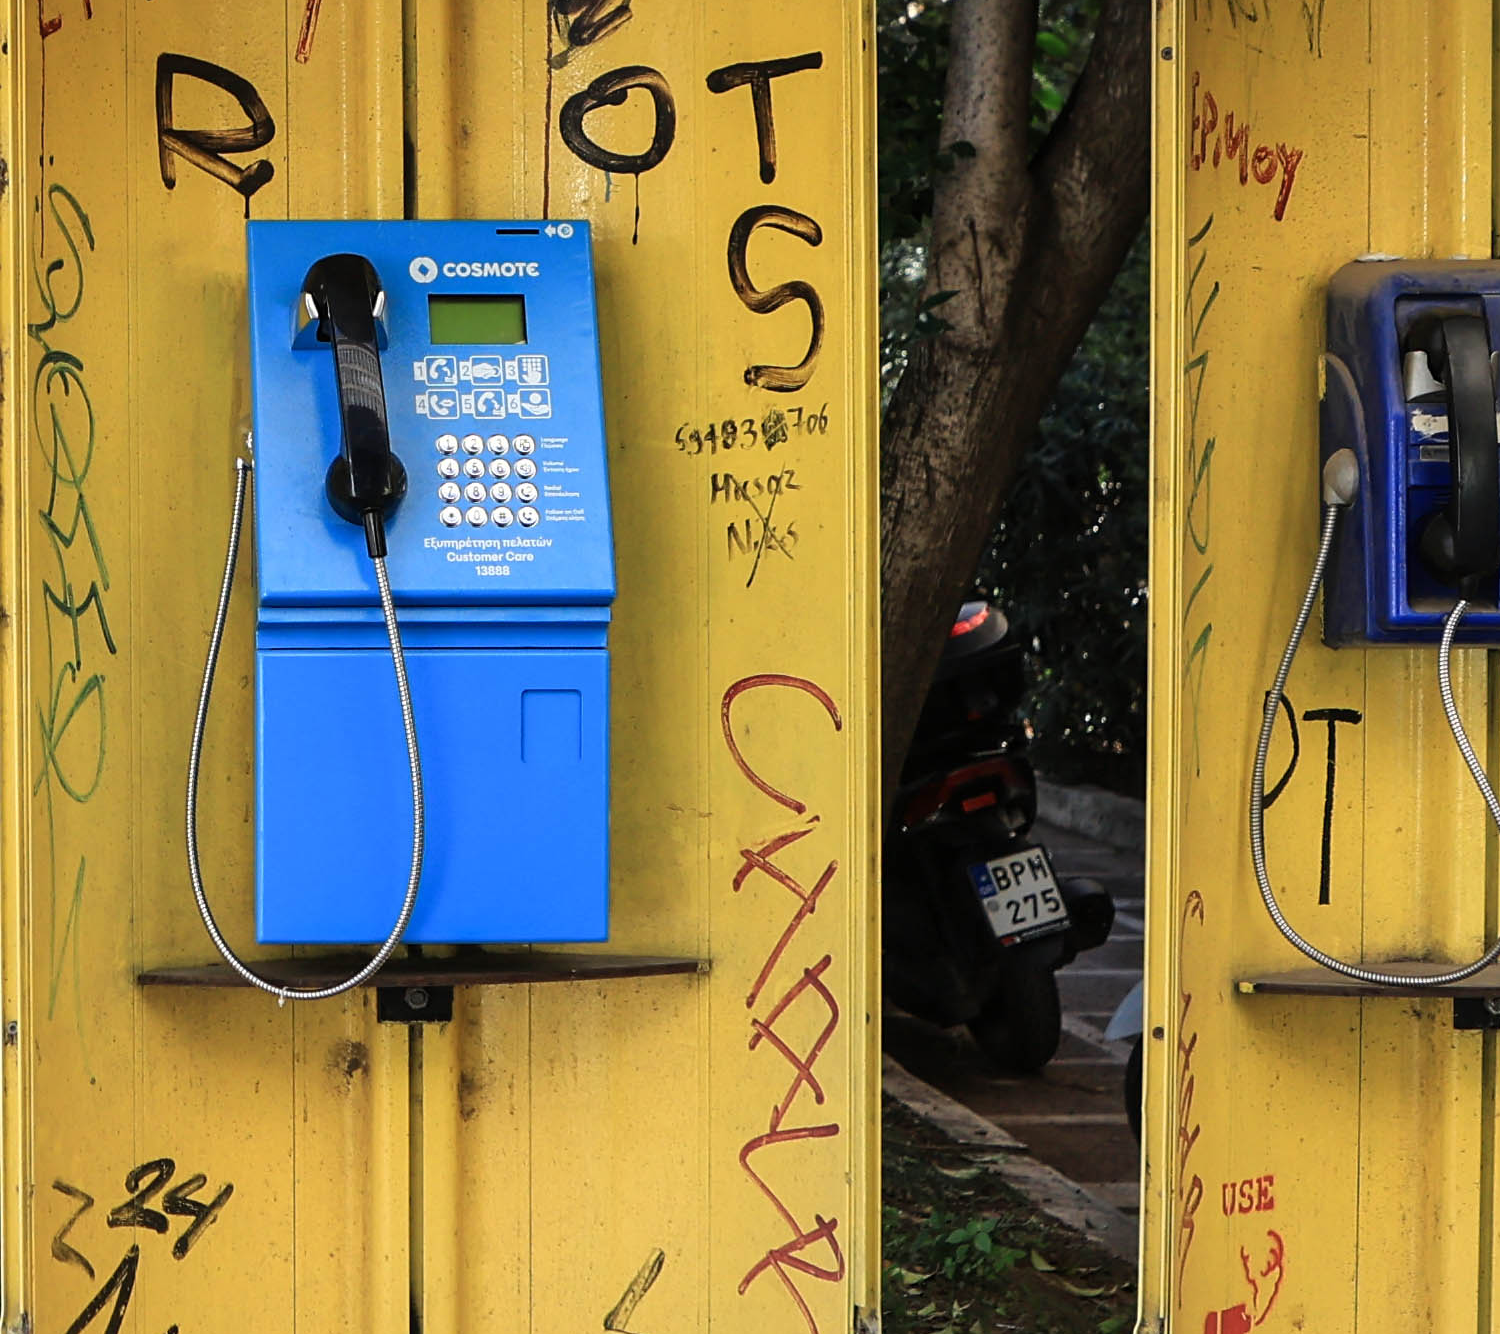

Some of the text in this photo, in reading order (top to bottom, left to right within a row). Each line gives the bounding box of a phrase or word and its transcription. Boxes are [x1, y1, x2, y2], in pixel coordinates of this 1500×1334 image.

[443, 262, 540, 277] COSMOTE
[424, 536, 553, 549] Εξυπηρέτηση πελατών
[447, 552, 534, 562] Customer Care
[475, 565, 511, 576] 13888
[1006, 888, 1061, 925] 275
[1221, 1174, 1275, 1217] USE
